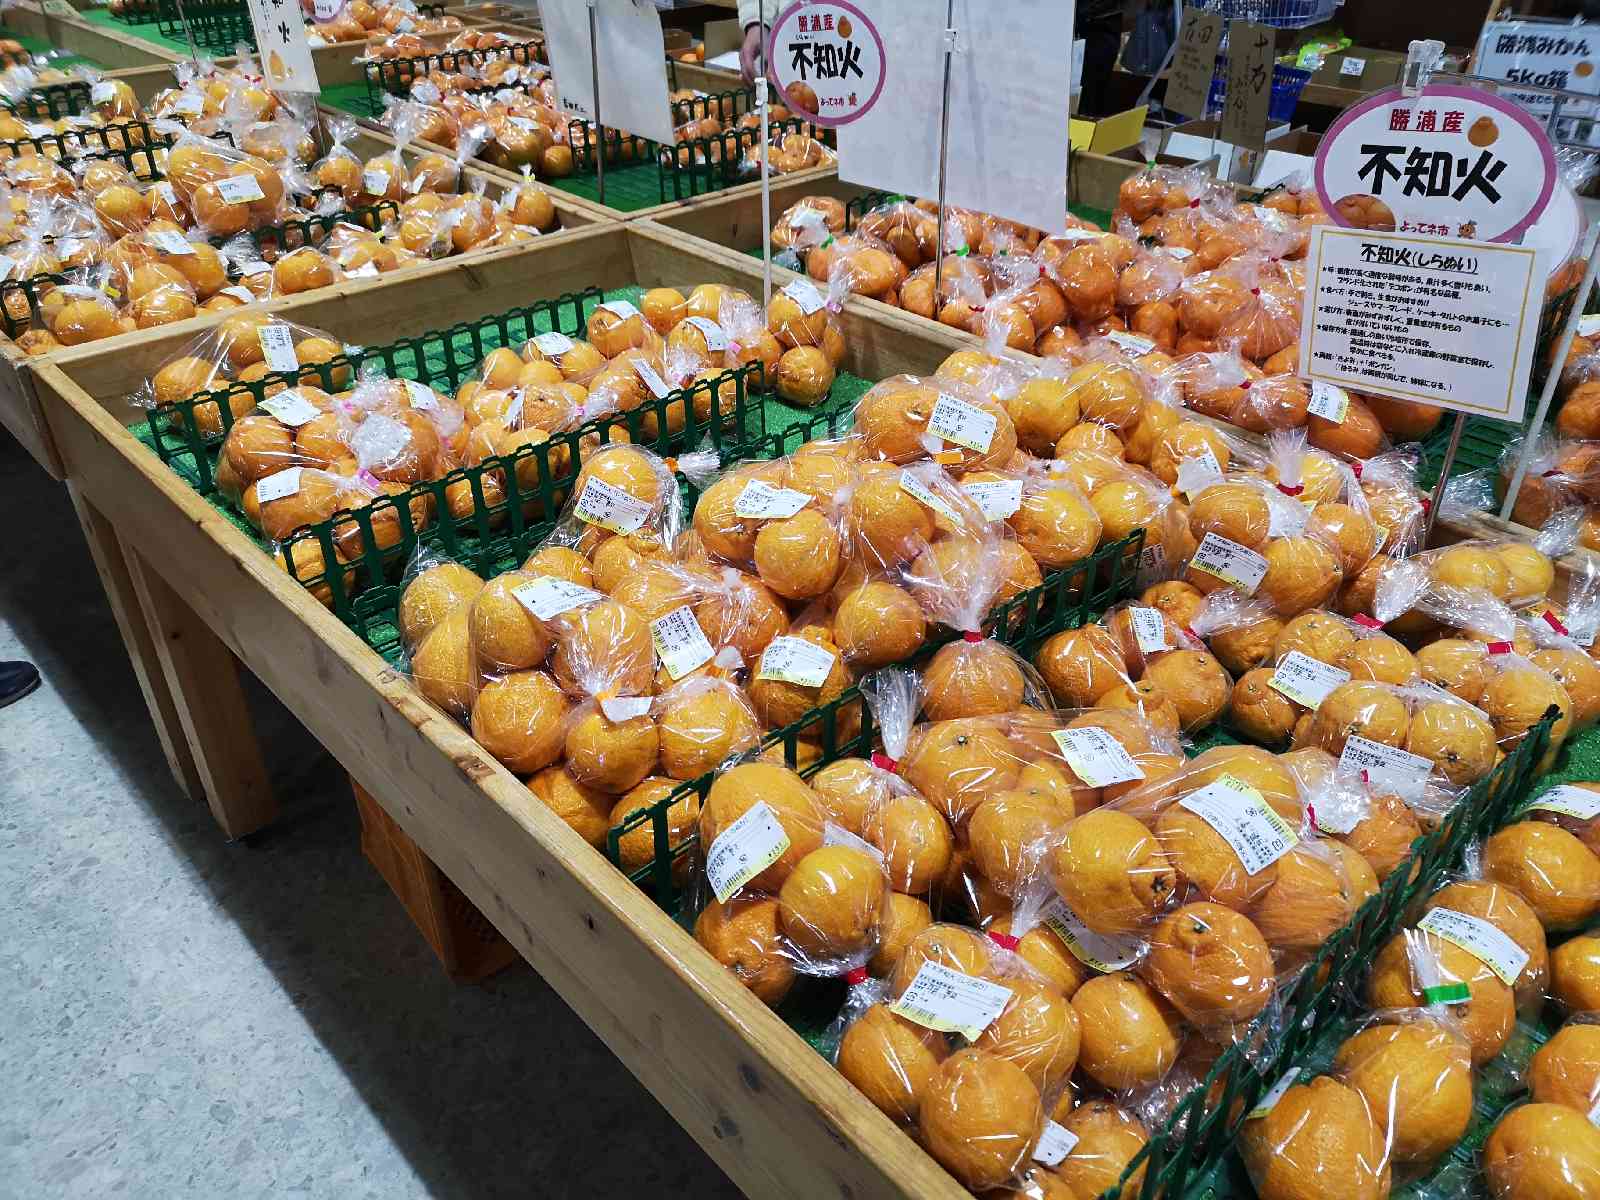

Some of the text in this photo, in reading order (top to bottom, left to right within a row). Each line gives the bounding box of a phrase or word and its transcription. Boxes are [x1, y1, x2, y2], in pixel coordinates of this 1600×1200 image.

[788, 40, 864, 81] 不知火
[1389, 109, 1465, 132] 勝浦産
[1357, 144, 1508, 204] 不知火
[1400, 220, 1450, 236] よってネ市
